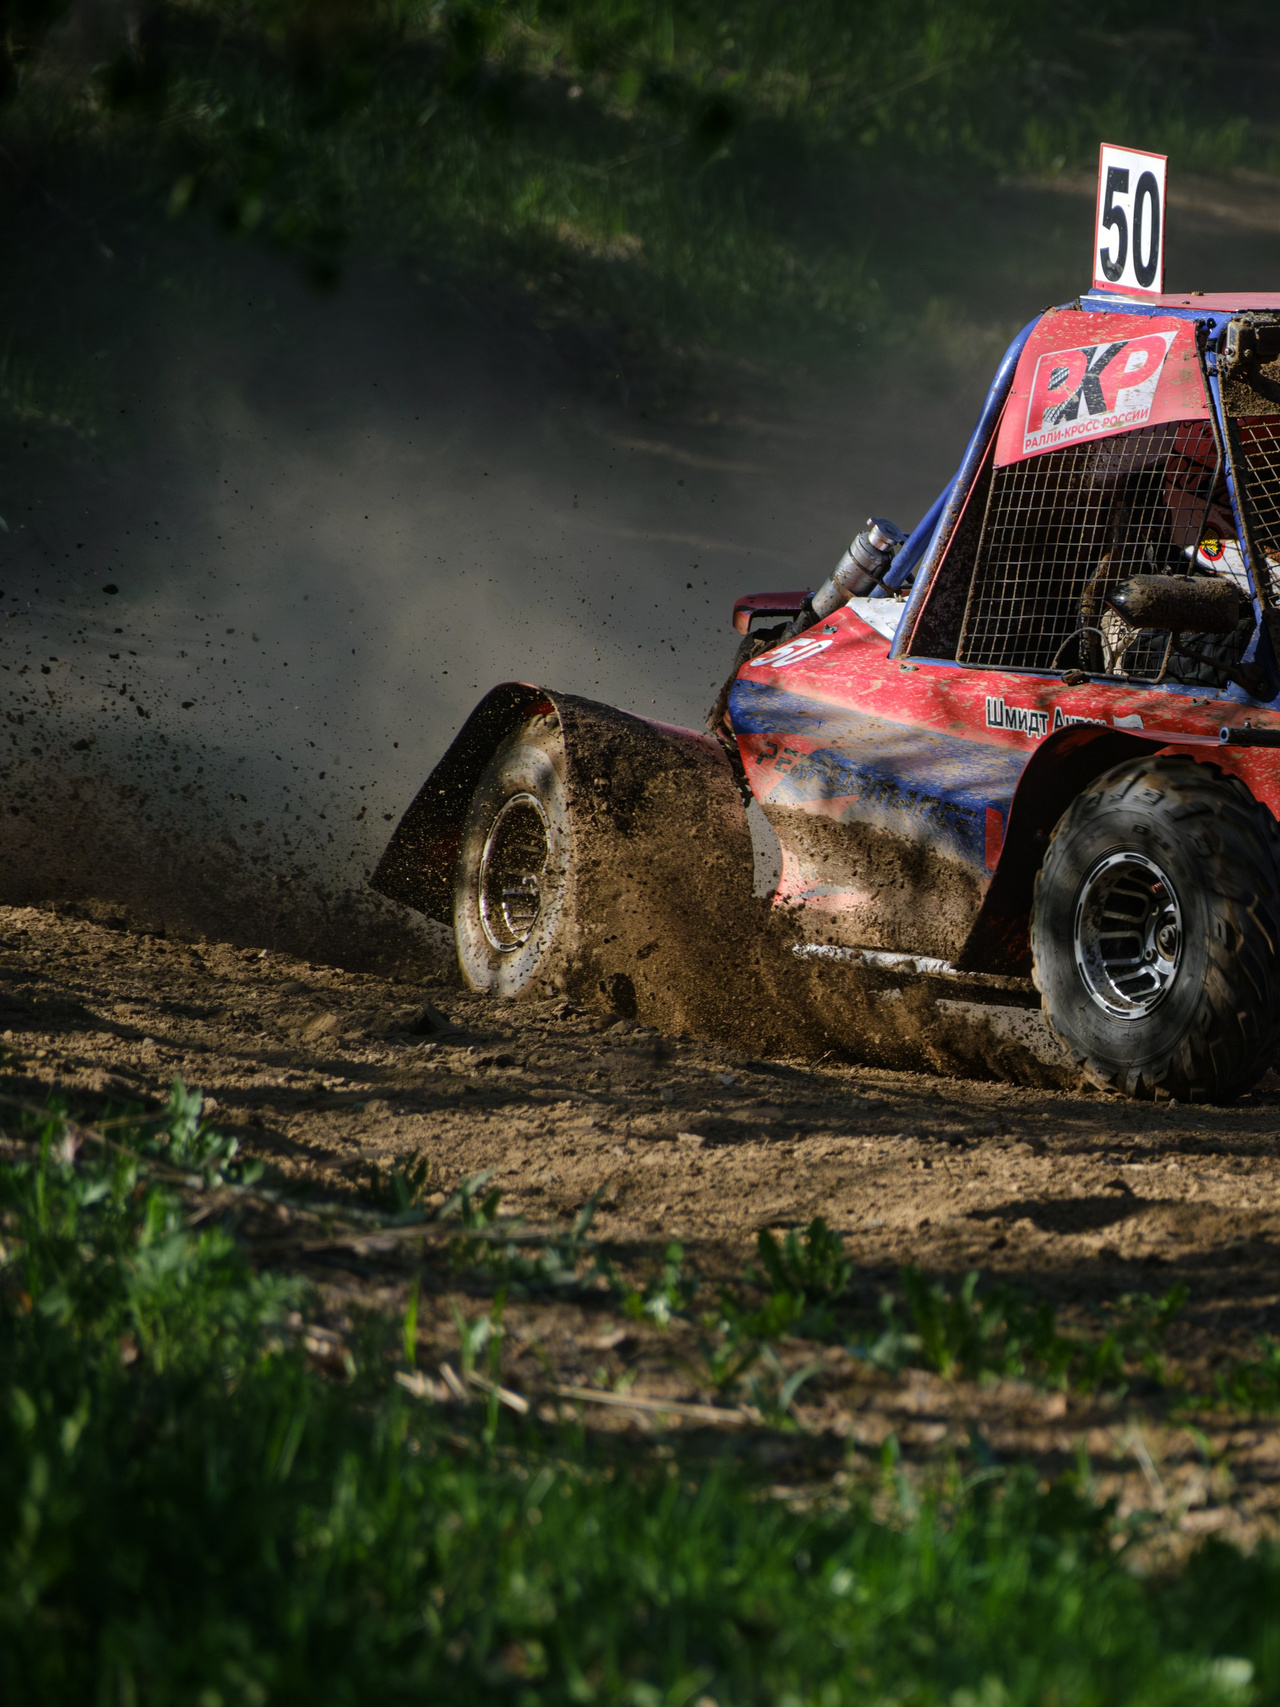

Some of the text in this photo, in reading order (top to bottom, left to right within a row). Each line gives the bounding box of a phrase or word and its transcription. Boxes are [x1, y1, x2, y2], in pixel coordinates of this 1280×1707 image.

[1100, 165, 1161, 288] 50
[1025, 407, 1149, 451] РАЛЛИ-КРОСС РОССИИ
[750, 637, 834, 668] 50
[986, 697, 1049, 739] Шмидт
